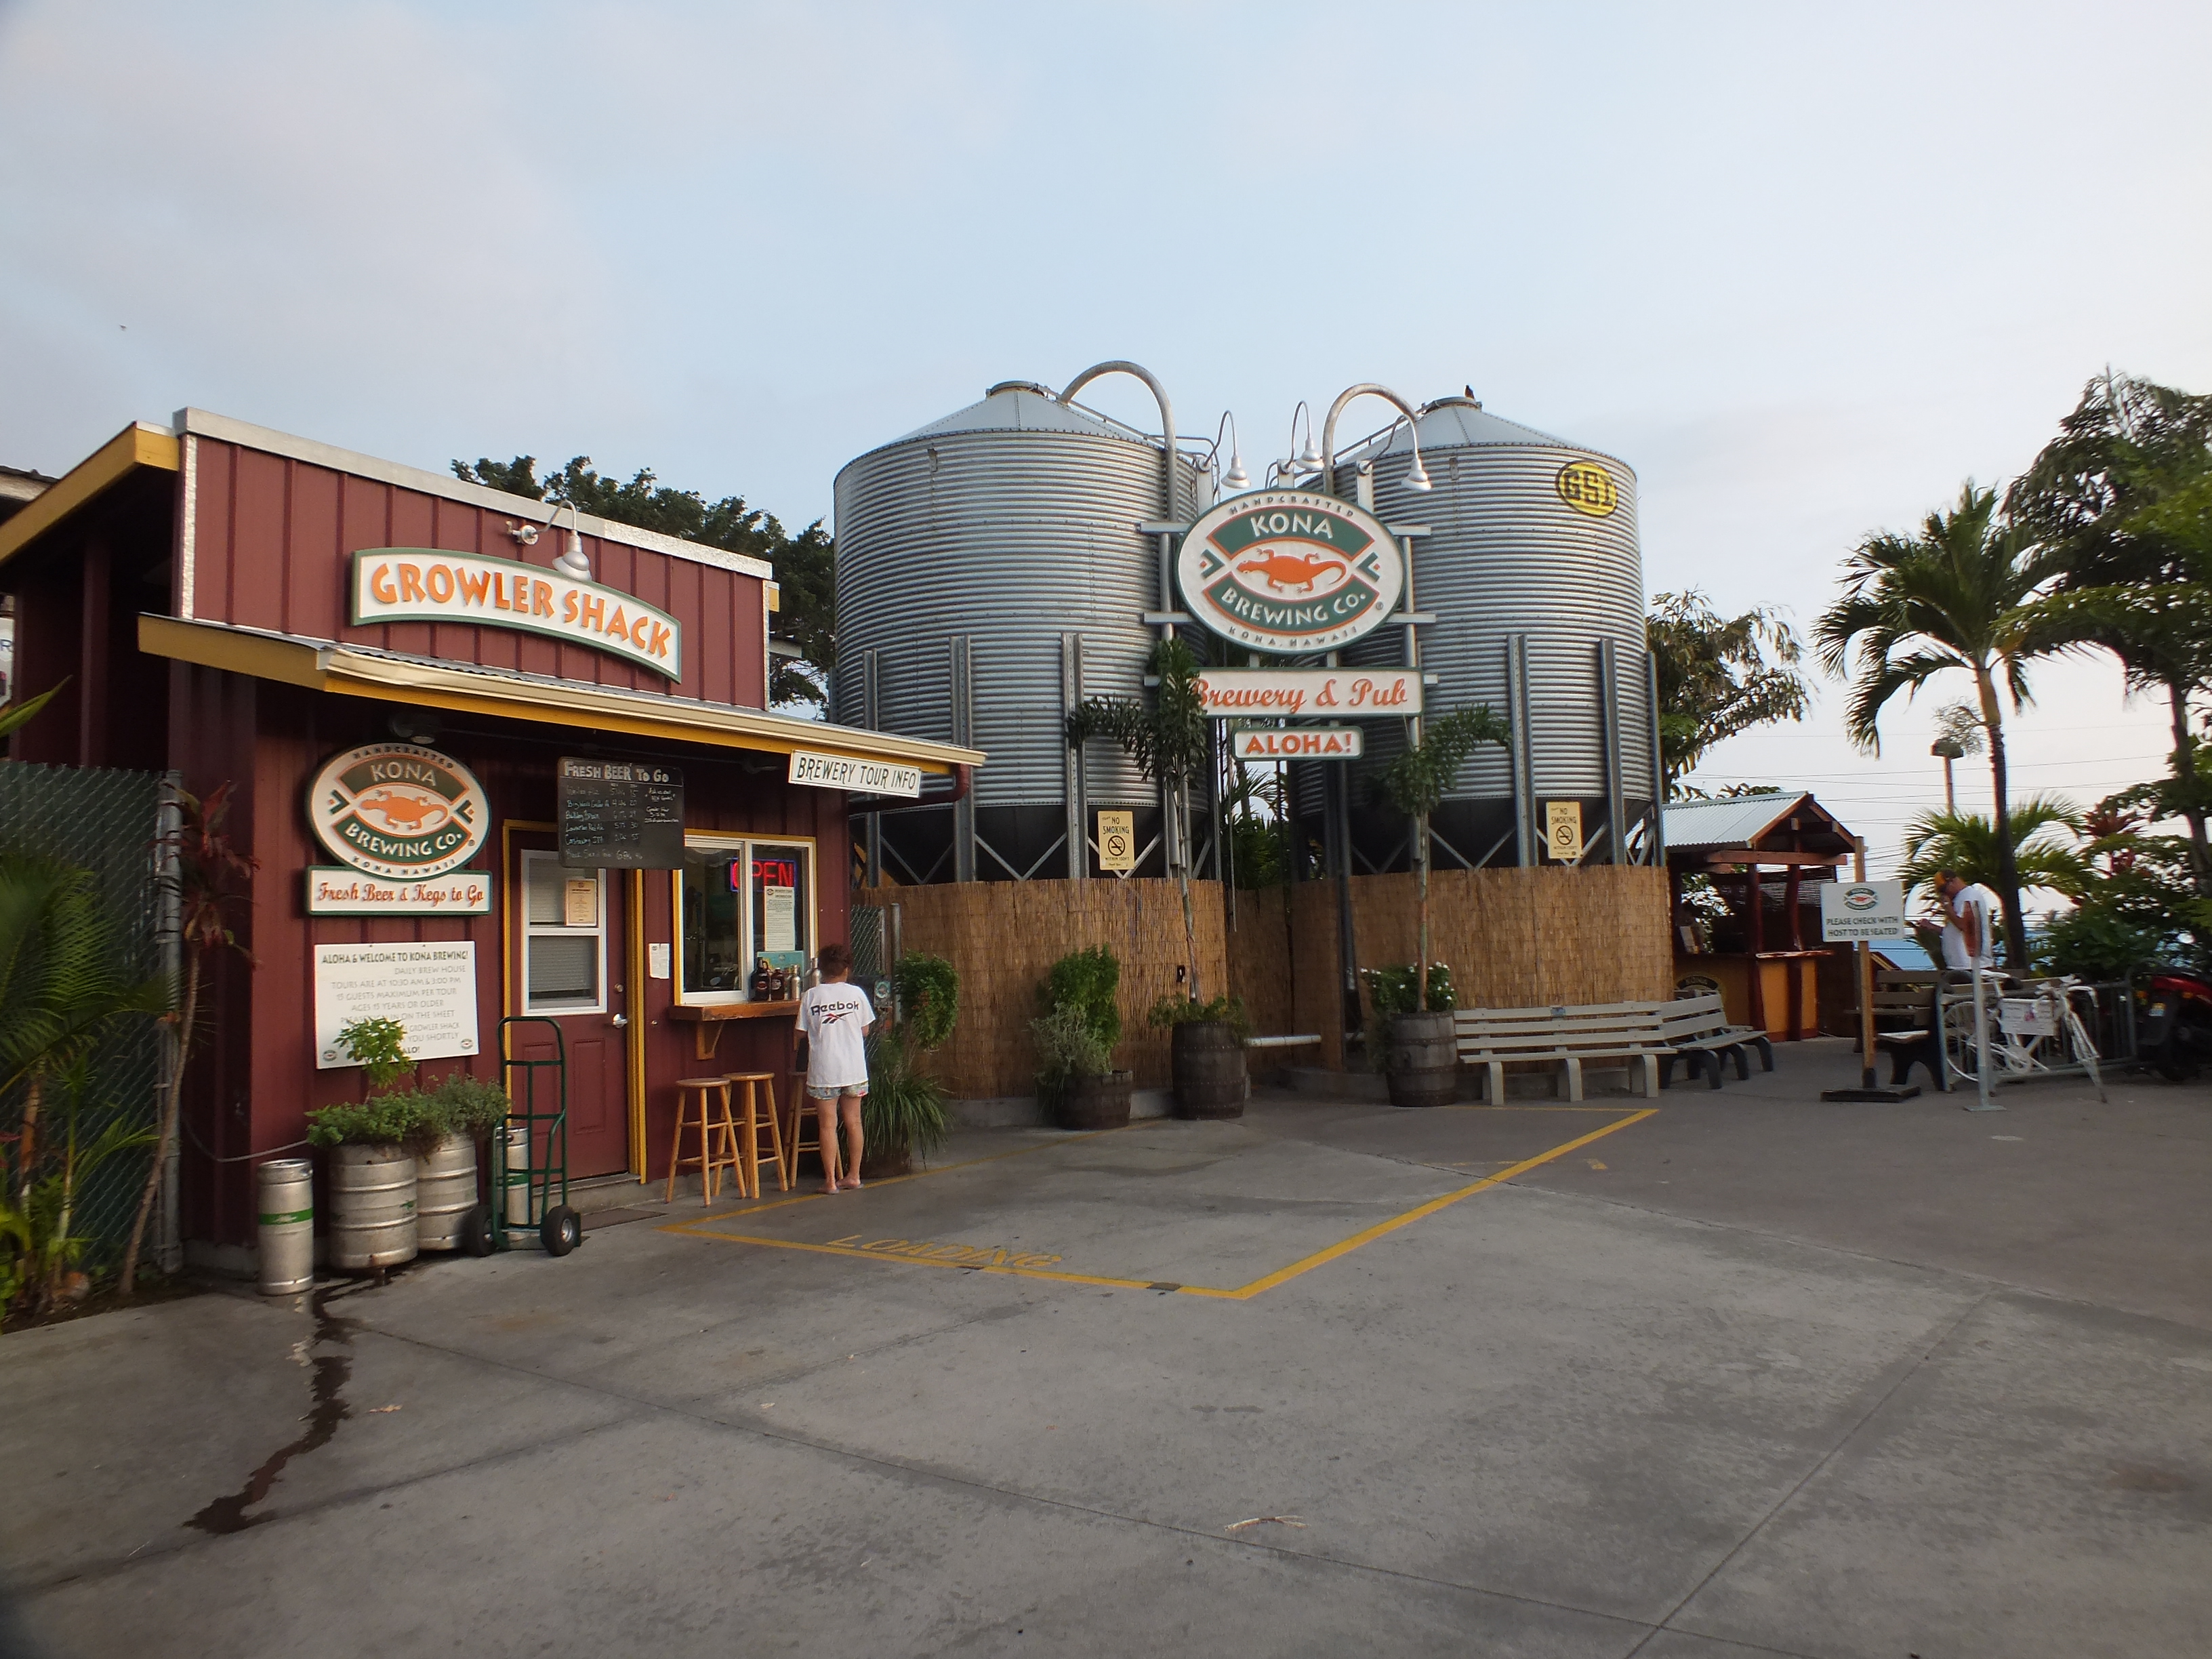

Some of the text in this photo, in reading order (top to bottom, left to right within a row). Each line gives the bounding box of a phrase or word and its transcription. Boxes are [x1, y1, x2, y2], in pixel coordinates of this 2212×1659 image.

[1229, 495, 1354, 517] HANDCRAFTED
[1250, 512, 1334, 539] KONA
[370, 562, 672, 659] GROWLER SHACK
[1221, 586, 1329, 626] BREWING
[1289, 626, 1357, 647] HAWAII
[1191, 677, 1408, 714] Brewery & Pub
[1244, 732, 1353, 755] ALOHA!
[370, 761, 436, 787] KONA
[604, 764, 632, 781] BEER
[796, 756, 917, 790] BREWERY TOUR INFO
[1111, 817, 1120, 825] NO
[1103, 825, 1130, 835] SMOKING
[344, 822, 433, 857] BREWING
[316, 881, 484, 907] Fresh Beer & Kegs to Go
[1826, 917, 1851, 926] PLEASE
[1853, 916, 1876, 925] CHECK
[1828, 928, 1846, 937] HOST
[1870, 927, 1898, 935] SEATED
[322, 954, 350, 964] ALOHA
[359, 952, 396, 963] WELCOME
[397, 952, 407, 962] TO
[409, 951, 432, 961] KONA
[433, 951, 468, 961] BREWING!
[441, 965, 466, 973] HOUSE
[331, 981, 358, 989] TOURS
[360, 980, 375, 988] ARE
[346, 991, 375, 1001] GUESTS
[377, 989, 419, 999] MAXIMUM
[422, 988, 434, 996] PER
[436, 987, 457, 996] TOUR
[351, 1003, 371, 1012] AGES
[382, 1002, 405, 1010] YEARS
[407, 1000, 418, 1009] OR
[420, 1000, 444, 1008] OLDER
[432, 1009, 455, 1018] SHEET
[810, 1001, 859, 1016] Reebok
[409, 1023, 438, 1032] GROWLER
[440, 1021, 459, 1030] SHACK
[408, 1032, 459, 1042] YOU SHORTLY
